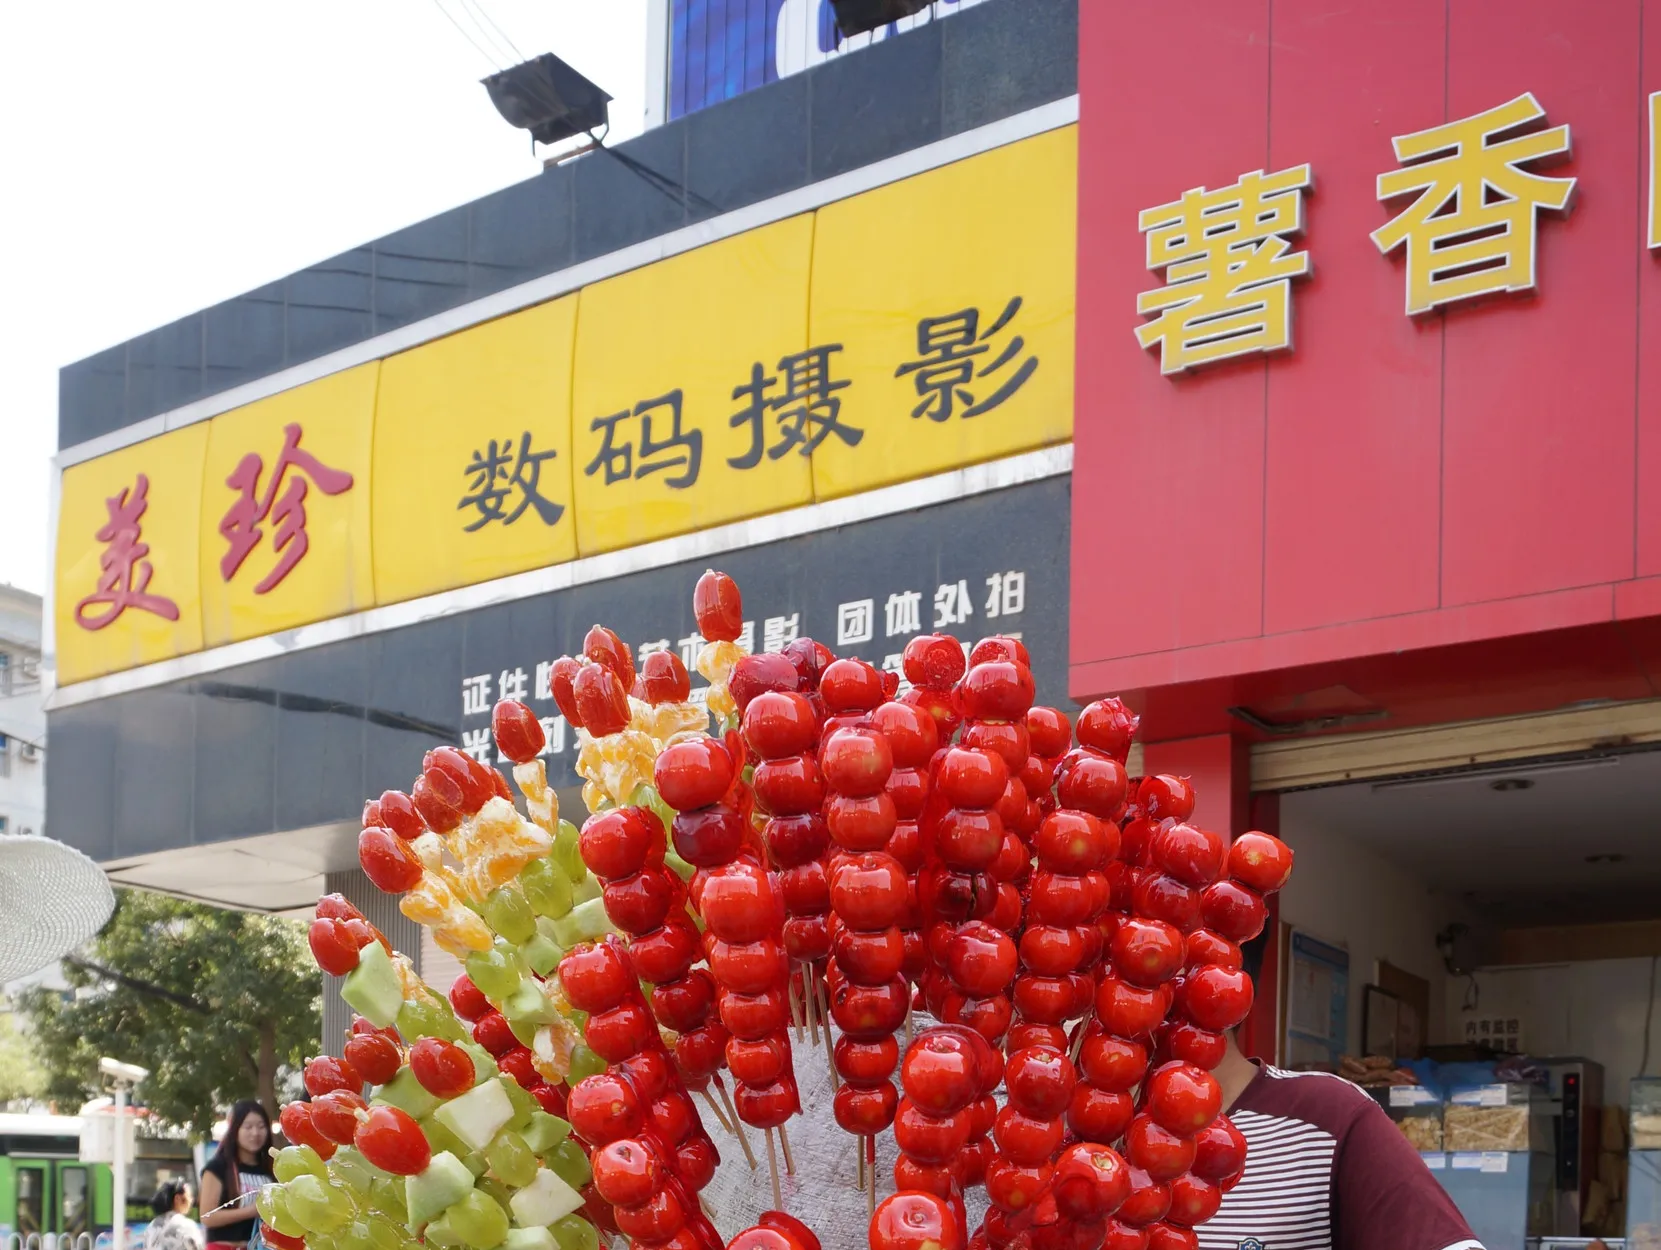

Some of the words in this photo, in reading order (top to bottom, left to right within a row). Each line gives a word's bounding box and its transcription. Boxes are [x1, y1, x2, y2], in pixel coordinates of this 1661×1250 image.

[1134, 91, 1661, 377] 薯香
[75, 423, 354, 632] 美珍
[457, 296, 1040, 533] 数码摄影
[836, 571, 1026, 647] 团体外拍
